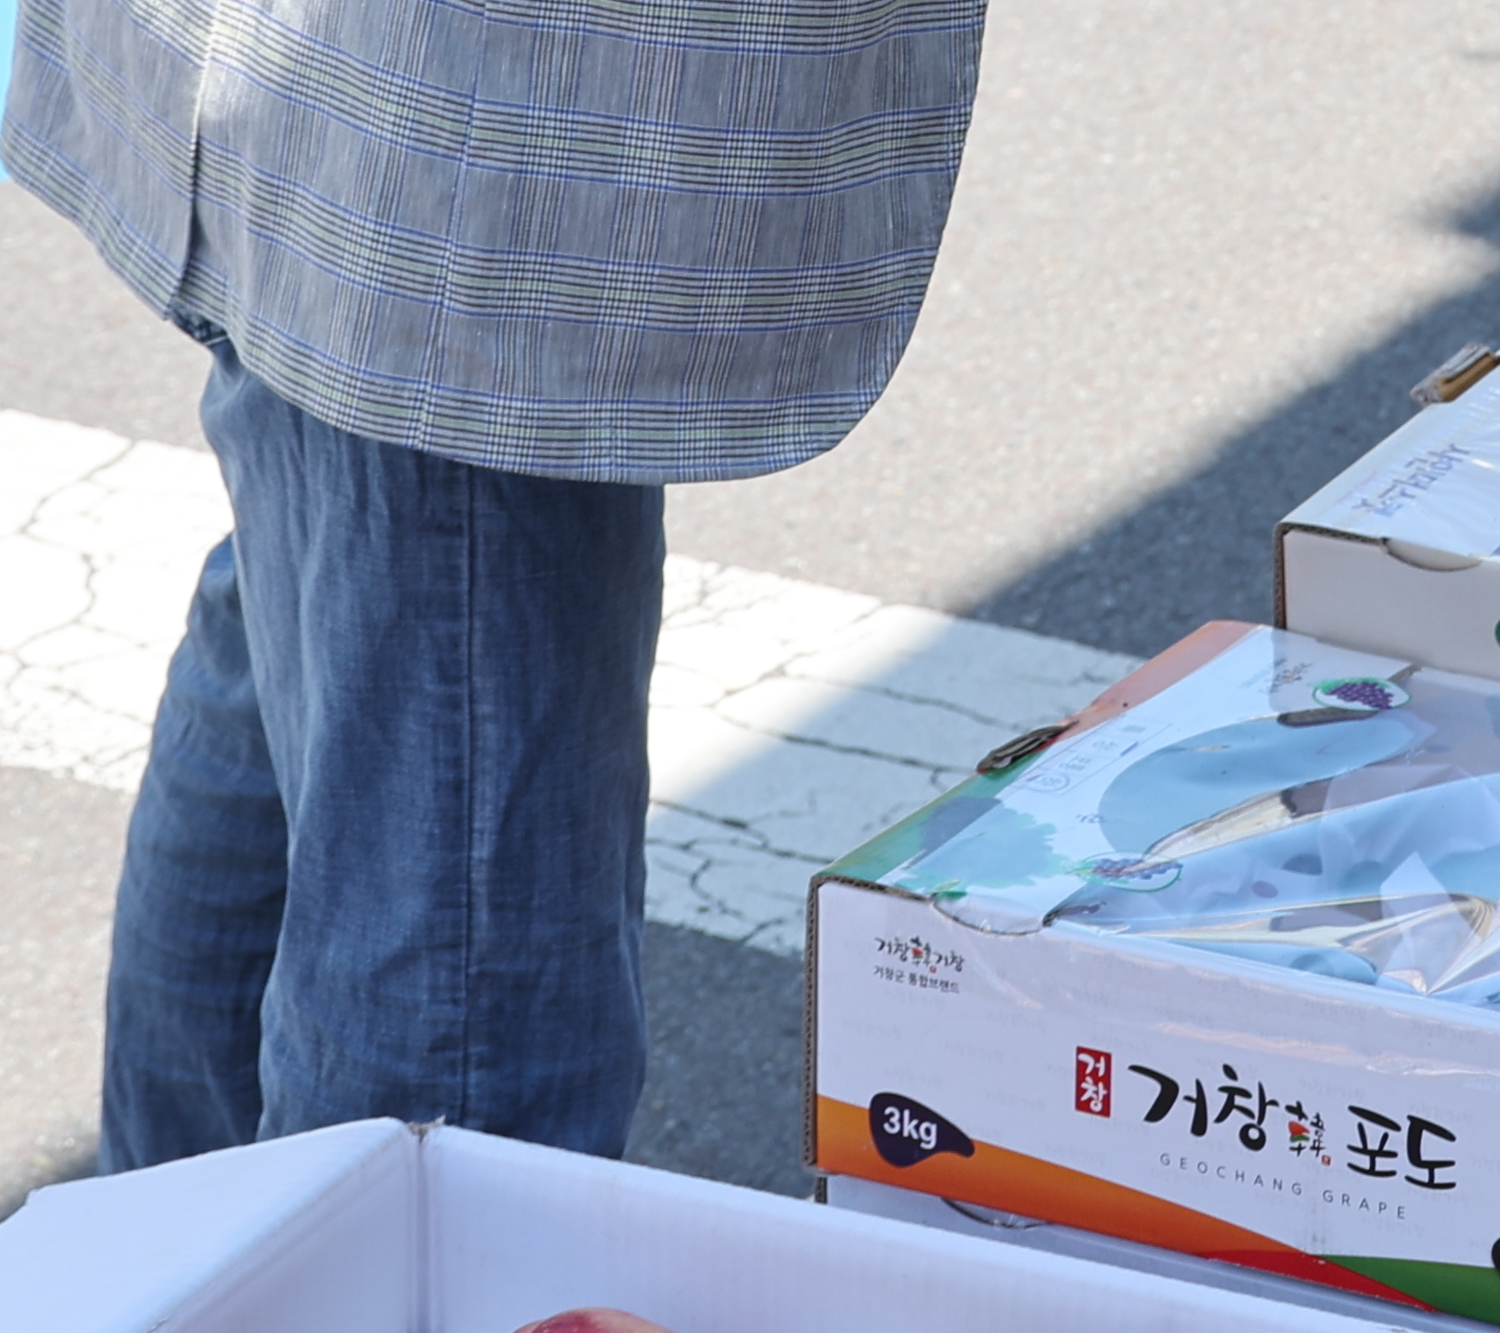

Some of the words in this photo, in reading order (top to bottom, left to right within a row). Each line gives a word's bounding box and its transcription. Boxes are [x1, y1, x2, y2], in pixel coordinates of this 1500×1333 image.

[1077, 1050, 1109, 1113] 거창
[882, 1106, 938, 1150] 3kg
[1346, 1104, 1457, 1190] 포도
[1160, 1152, 1303, 1197] GEOCHANG
[1322, 1188, 1407, 1220] GRAPE
